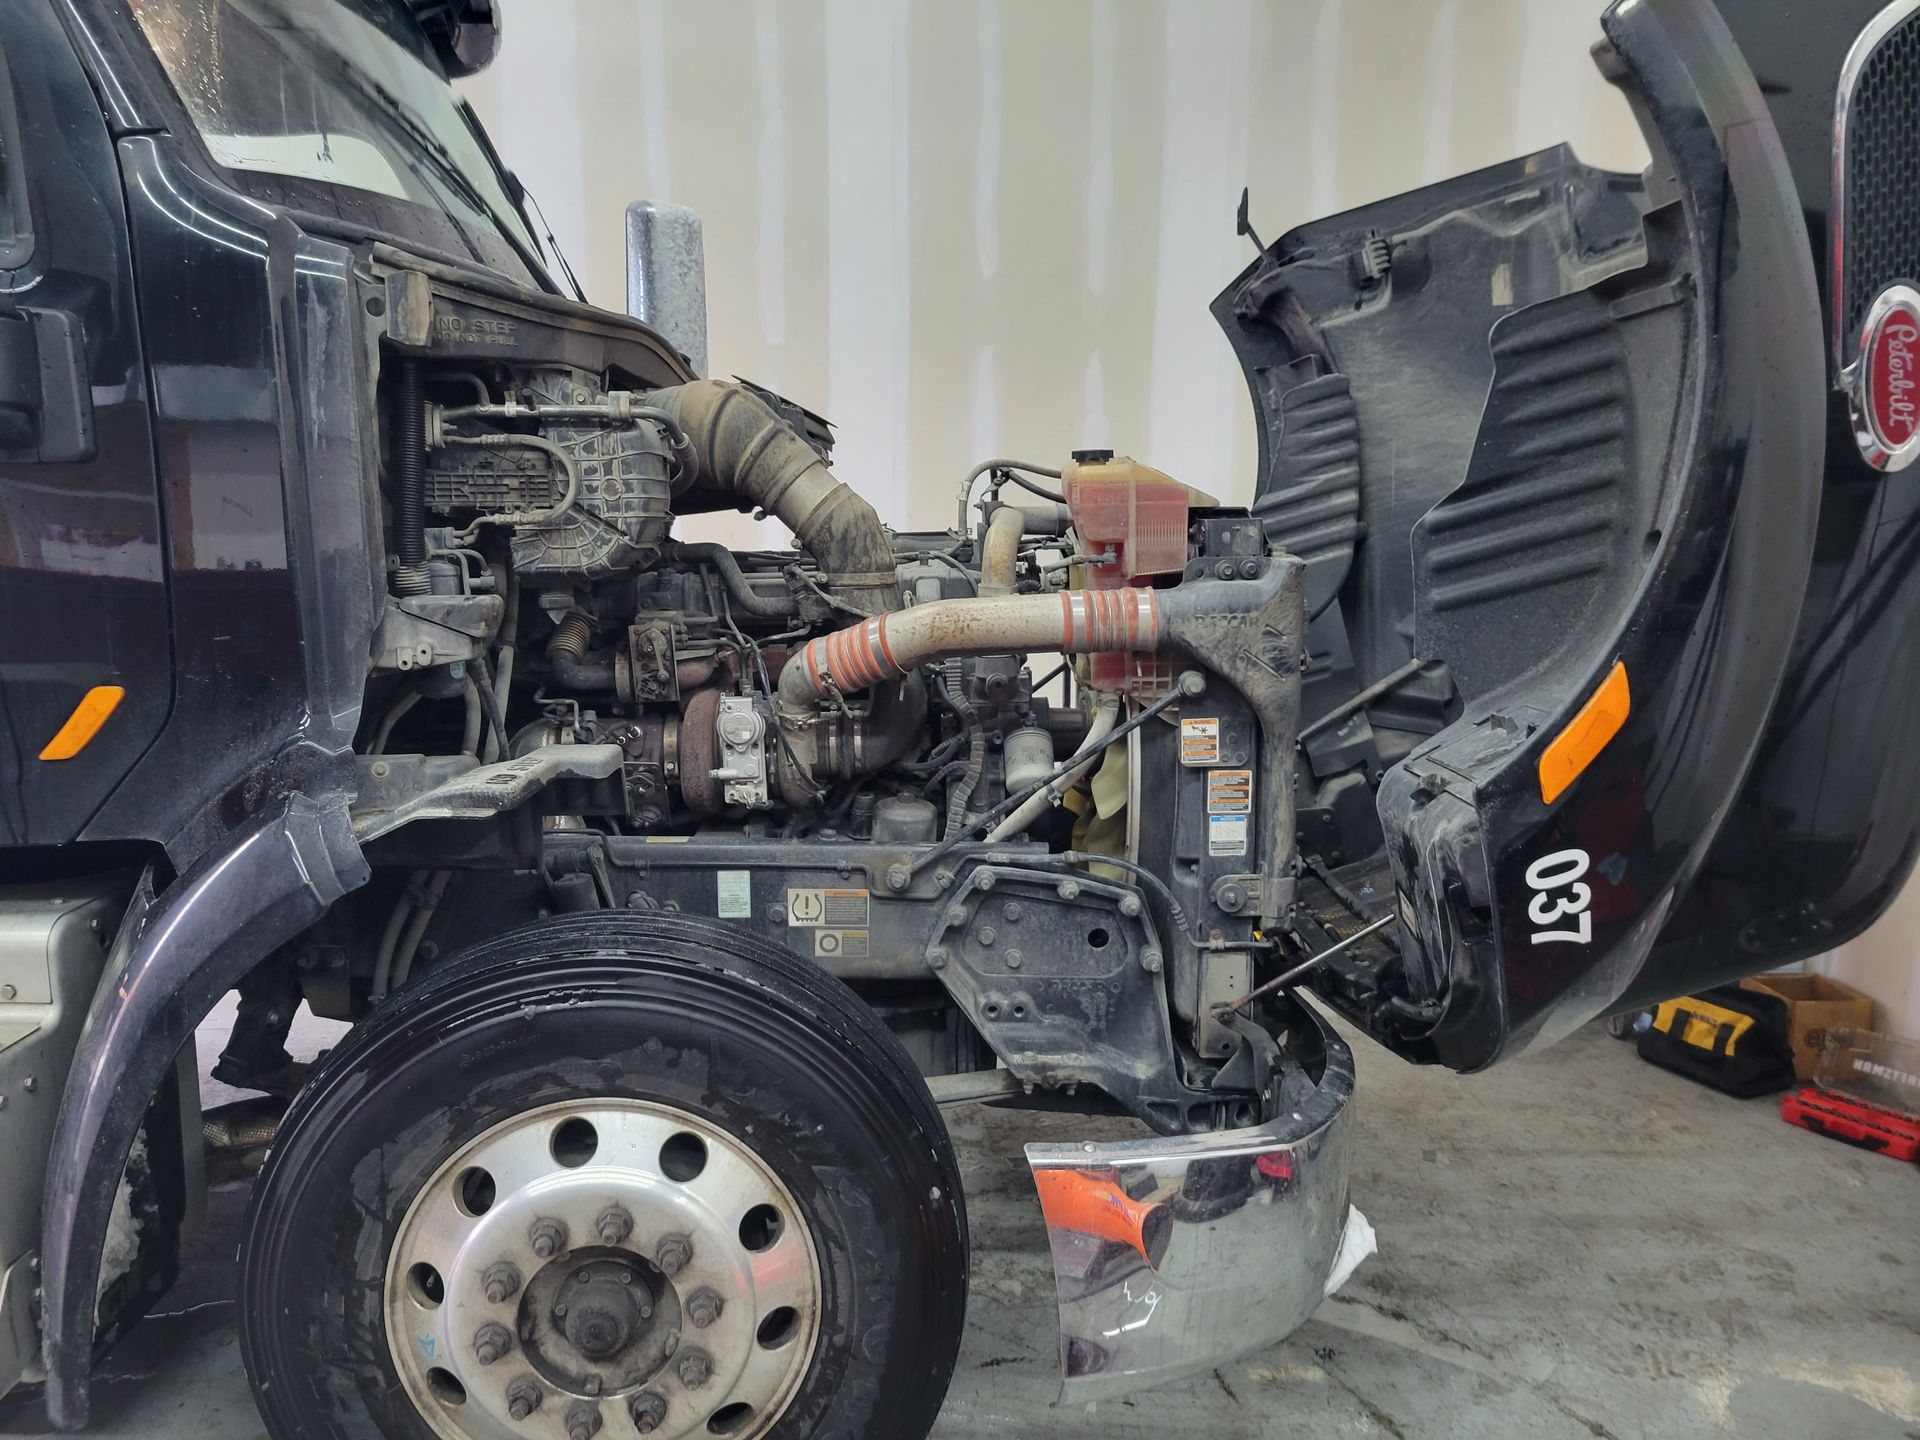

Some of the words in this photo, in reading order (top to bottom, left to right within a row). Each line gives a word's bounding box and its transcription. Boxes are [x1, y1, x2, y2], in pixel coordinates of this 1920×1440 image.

[437, 316, 463, 331] NO
[472, 319, 519, 335] STEP
[434, 332, 452, 342] DO
[457, 333, 481, 344] NOT
[487, 335, 520, 347] PULL
[1886, 324, 1919, 432] Peterbilt
[485, 773, 518, 785] NO
[1525, 848, 1592, 945] 037
